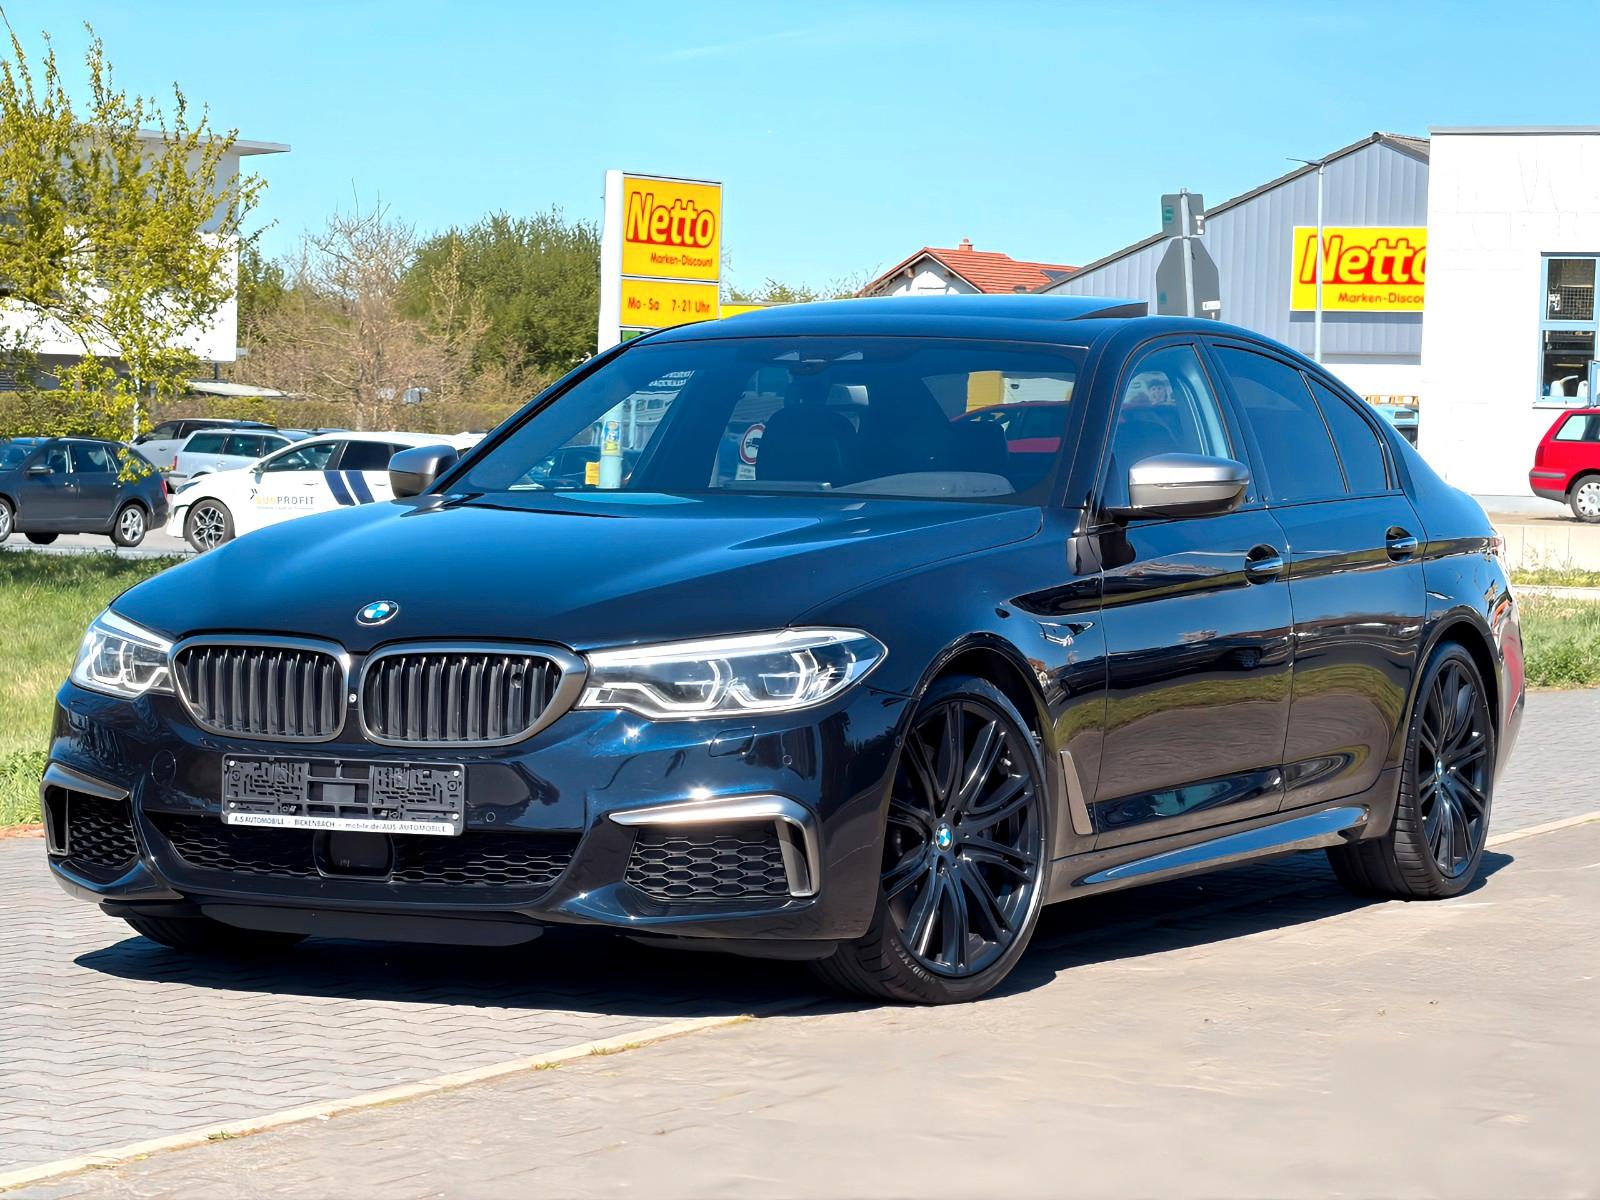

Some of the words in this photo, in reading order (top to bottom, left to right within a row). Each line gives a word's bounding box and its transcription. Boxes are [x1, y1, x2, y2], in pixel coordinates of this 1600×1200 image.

[626, 191, 715, 248] Netto
[651, 252, 713, 267] Marken-Discount
[627, 297, 640, 309] Mo
[649, 298, 660, 310] Sa
[695, 301, 710, 313] Uhr
[1338, 292, 1424, 304] Marken-Disco
[294, 819, 335, 828] BICKENBACH
